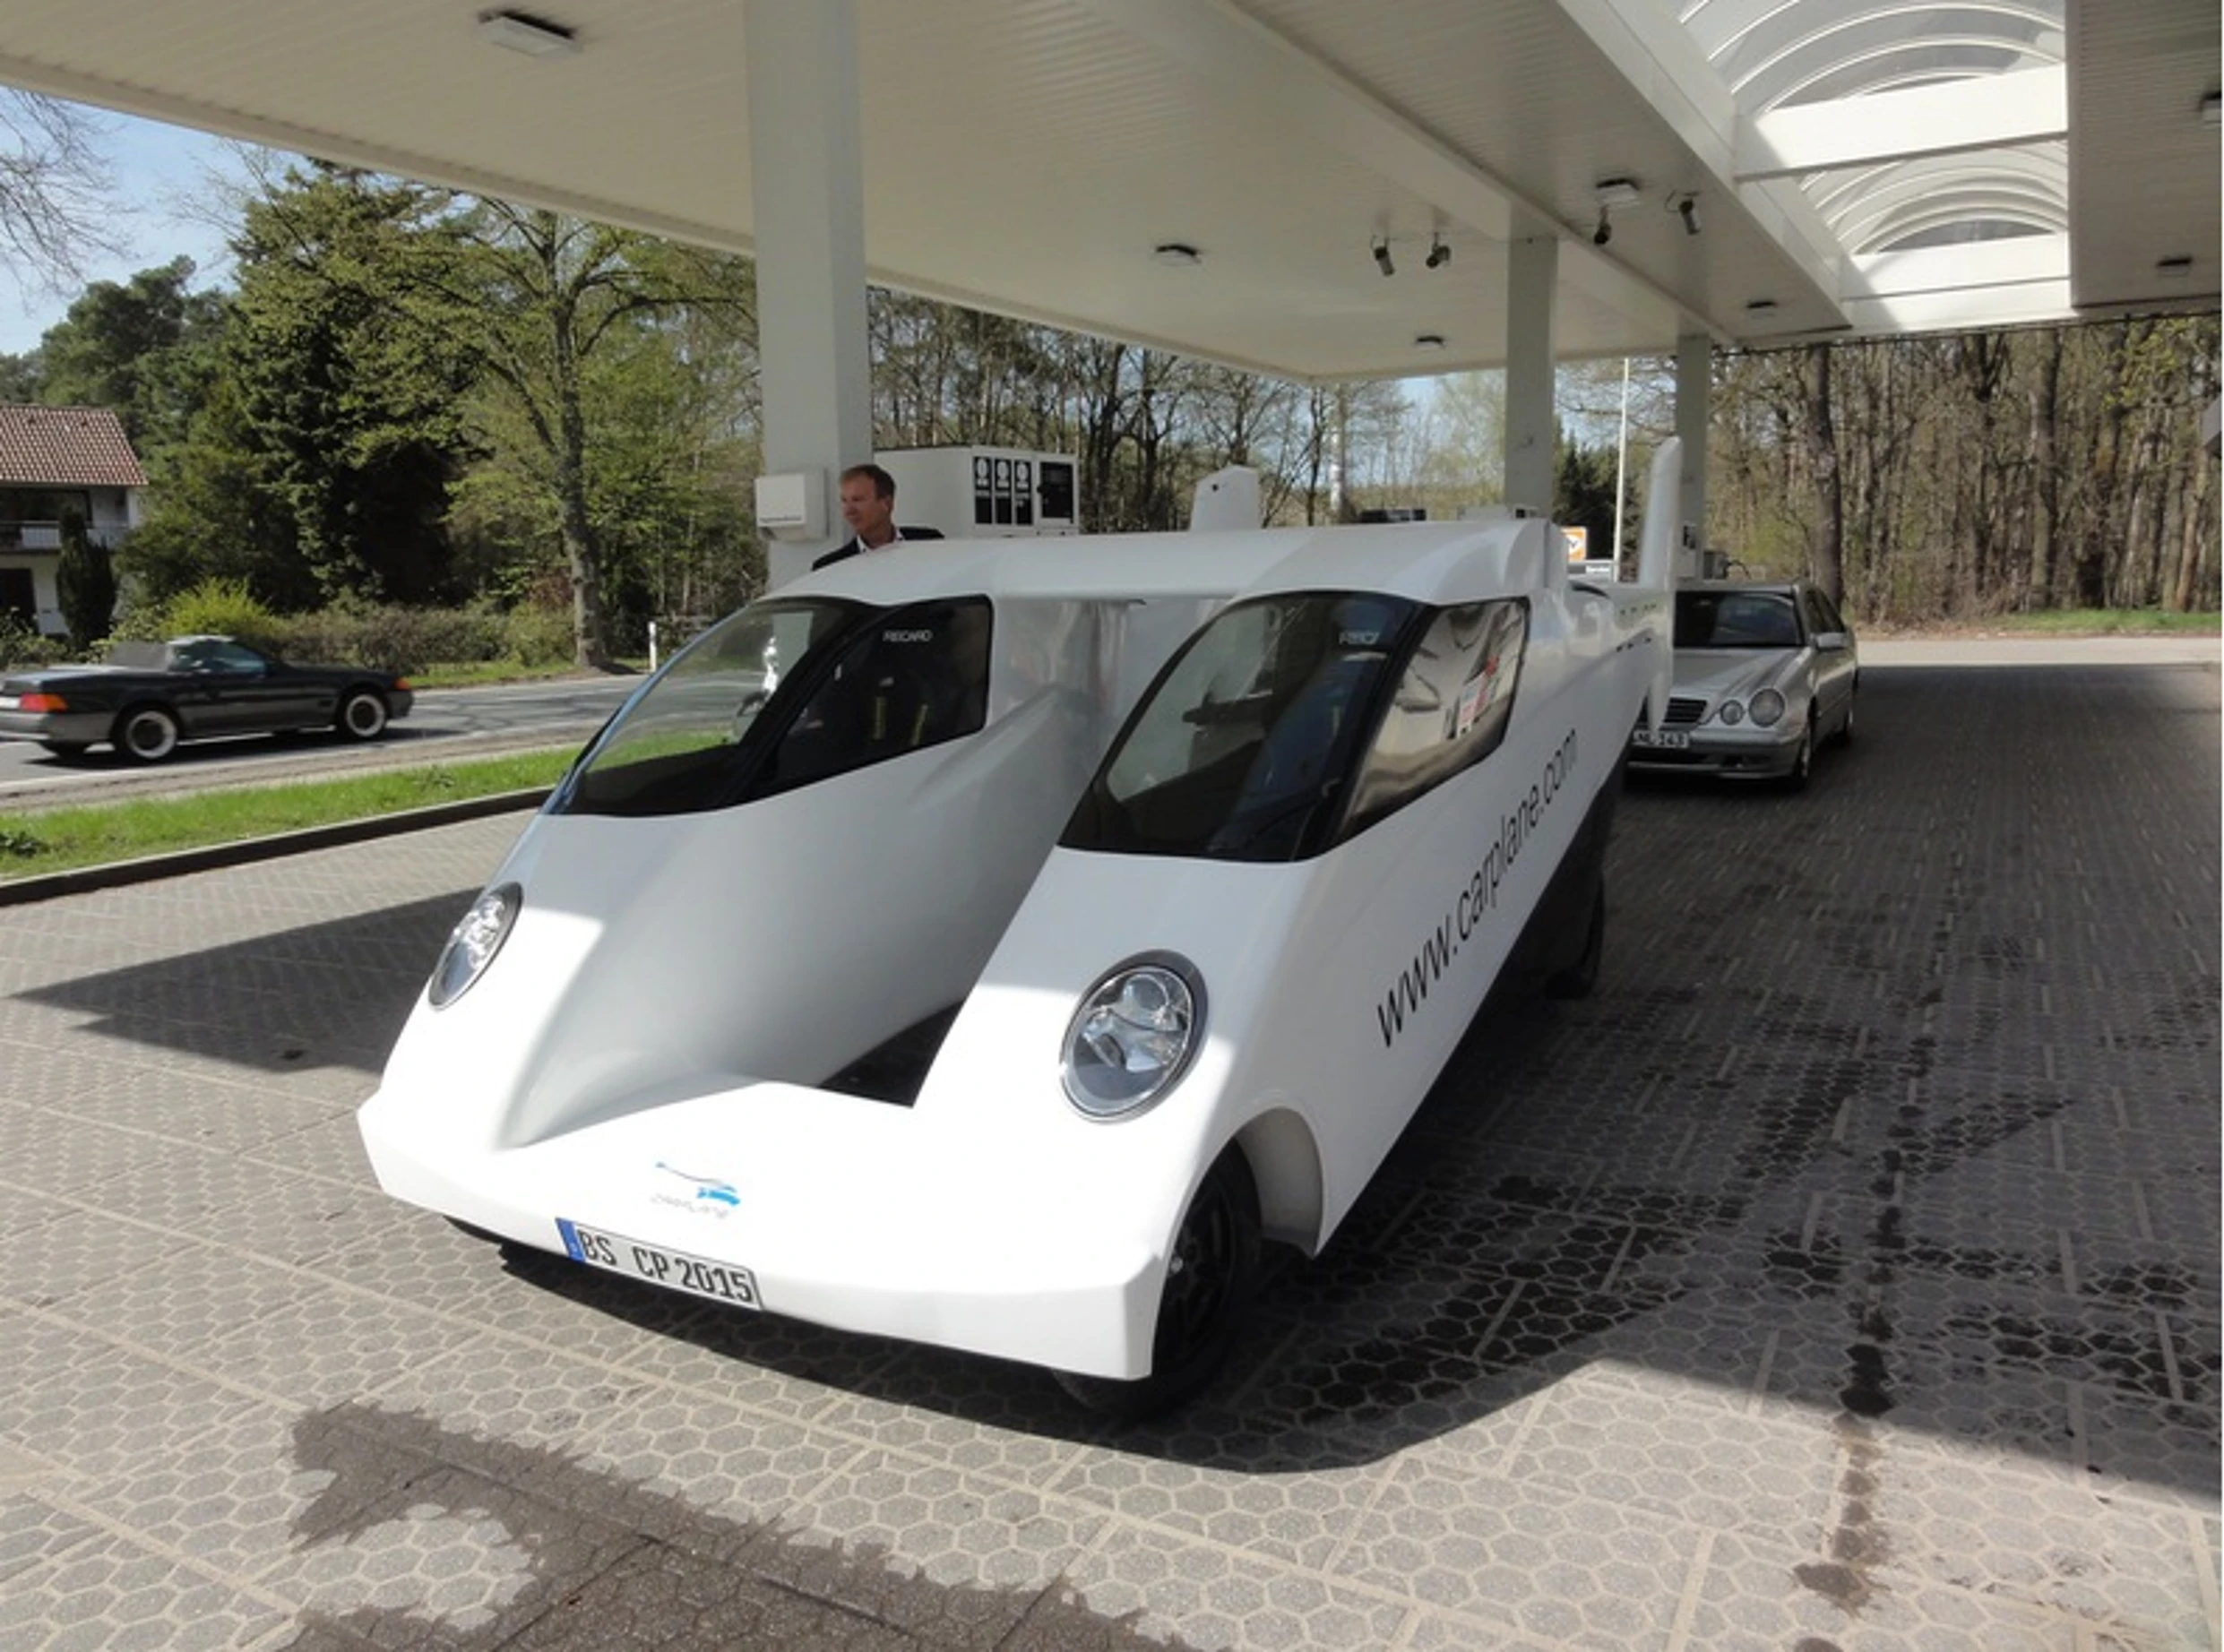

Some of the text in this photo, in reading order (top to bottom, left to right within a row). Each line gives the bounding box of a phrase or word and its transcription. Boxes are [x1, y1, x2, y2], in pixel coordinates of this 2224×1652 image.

[1376, 727, 1579, 1049] www.carplane.com
[576, 1228, 752, 1303] BS CP 2015
